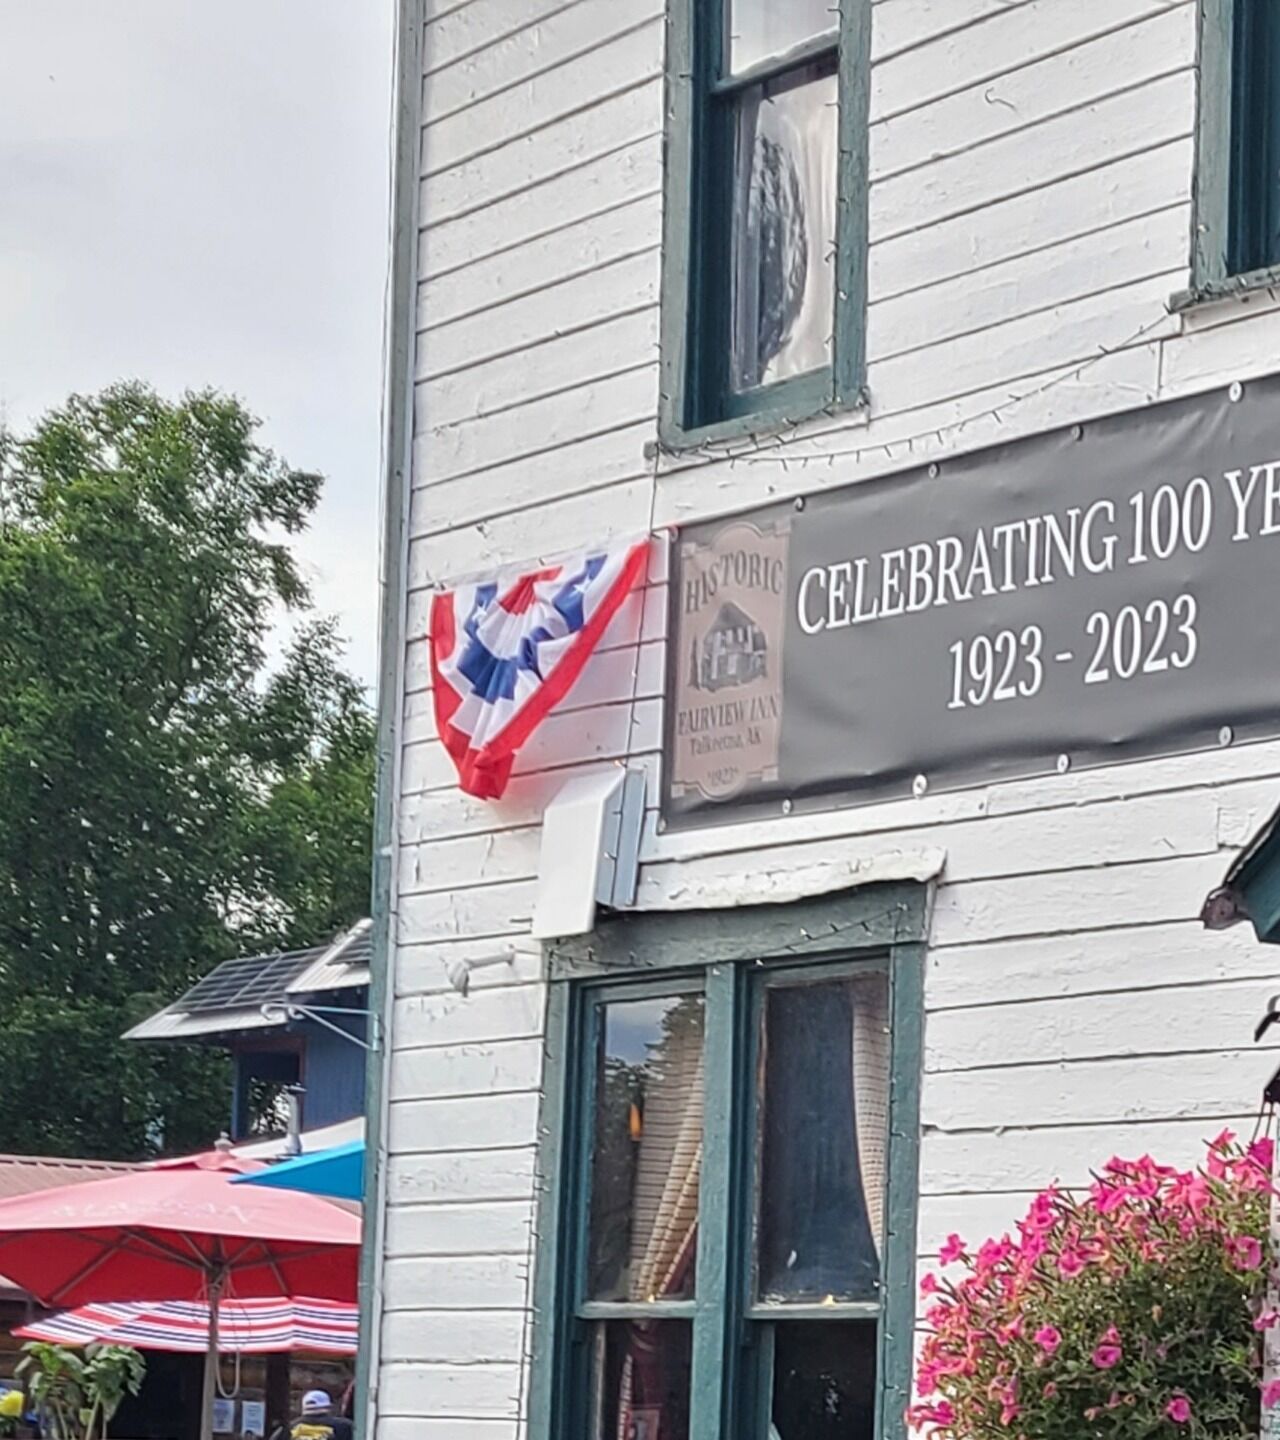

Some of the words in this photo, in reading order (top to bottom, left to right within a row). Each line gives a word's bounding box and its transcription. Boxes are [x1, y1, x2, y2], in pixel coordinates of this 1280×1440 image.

[685, 550, 783, 614] HISTORIC
[798, 501, 1115, 633] CELEBRATING
[1127, 478, 1212, 563] 100
[946, 624, 1042, 708] 1923
[1085, 595, 1198, 684] 2023
[678, 700, 744, 736] FAIRVIEW
[750, 695, 777, 721] INN
